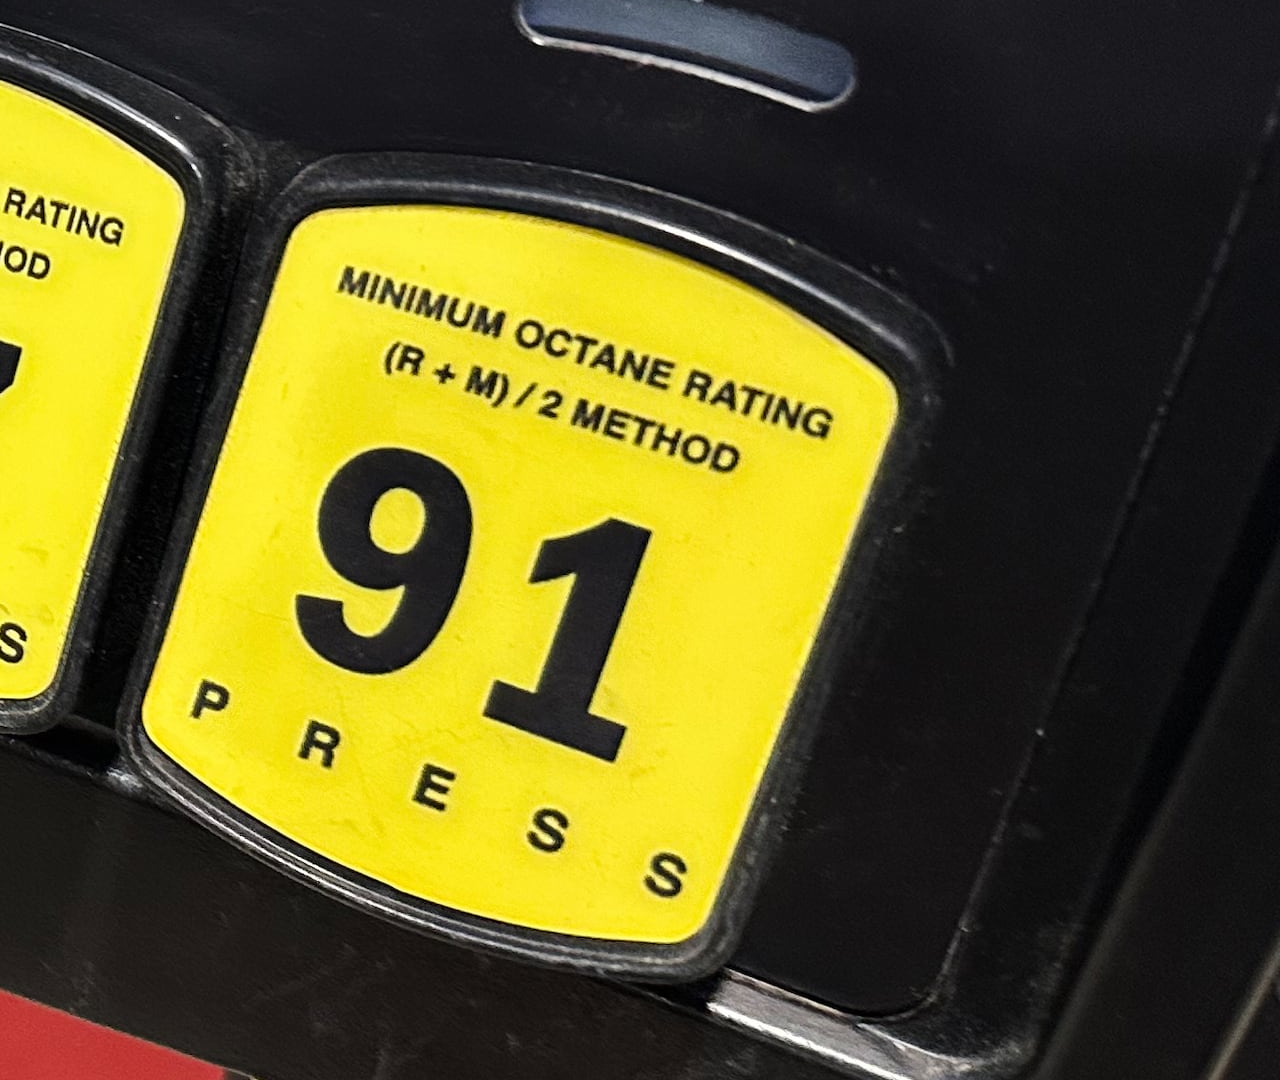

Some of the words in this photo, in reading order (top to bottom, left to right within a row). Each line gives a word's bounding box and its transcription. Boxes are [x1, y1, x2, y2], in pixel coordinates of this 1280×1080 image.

[3, 186, 126, 248] RATING
[336, 265, 508, 339] MINIMUM
[514, 318, 678, 390] OCTANE
[682, 367, 835, 440] RATING
[569, 398, 742, 475] METHOD
[294, 446, 653, 764] 91
